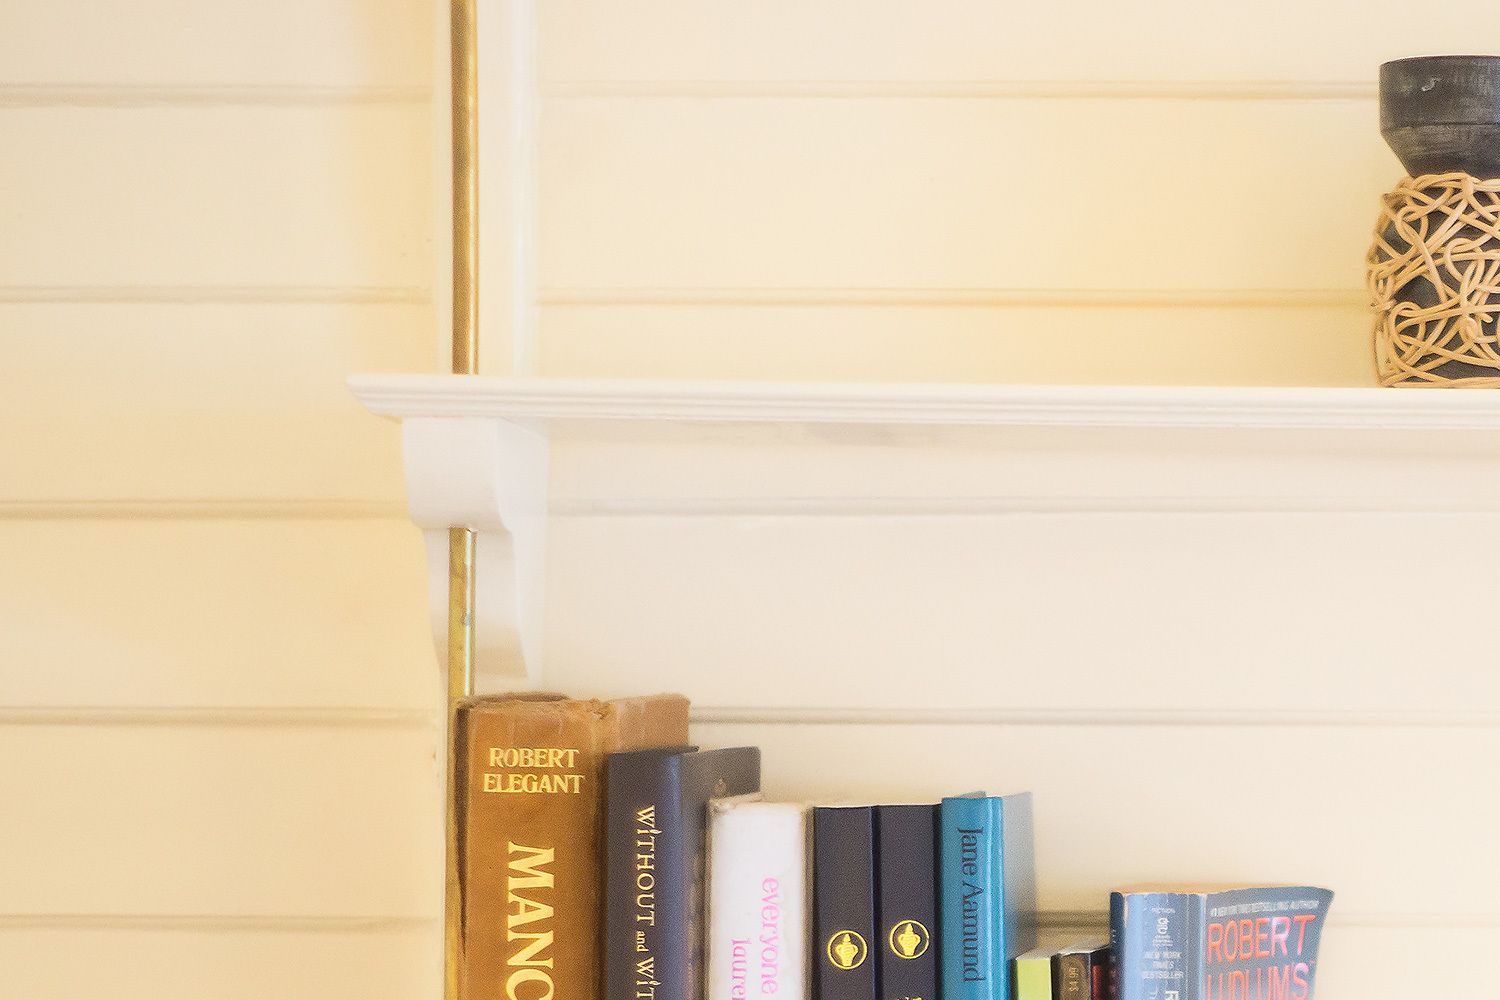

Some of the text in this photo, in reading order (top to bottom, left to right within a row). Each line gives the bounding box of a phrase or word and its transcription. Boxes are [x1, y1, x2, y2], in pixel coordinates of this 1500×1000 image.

[489, 747, 580, 769] ROBERT
[483, 774, 585, 795] ELEGANT
[637, 804, 661, 926] WITHOUT
[957, 827, 987, 983] Jane Aamund
[636, 931, 647, 952] and
[759, 877, 780, 995] everyone
[1206, 914, 1316, 965] ROBERT
